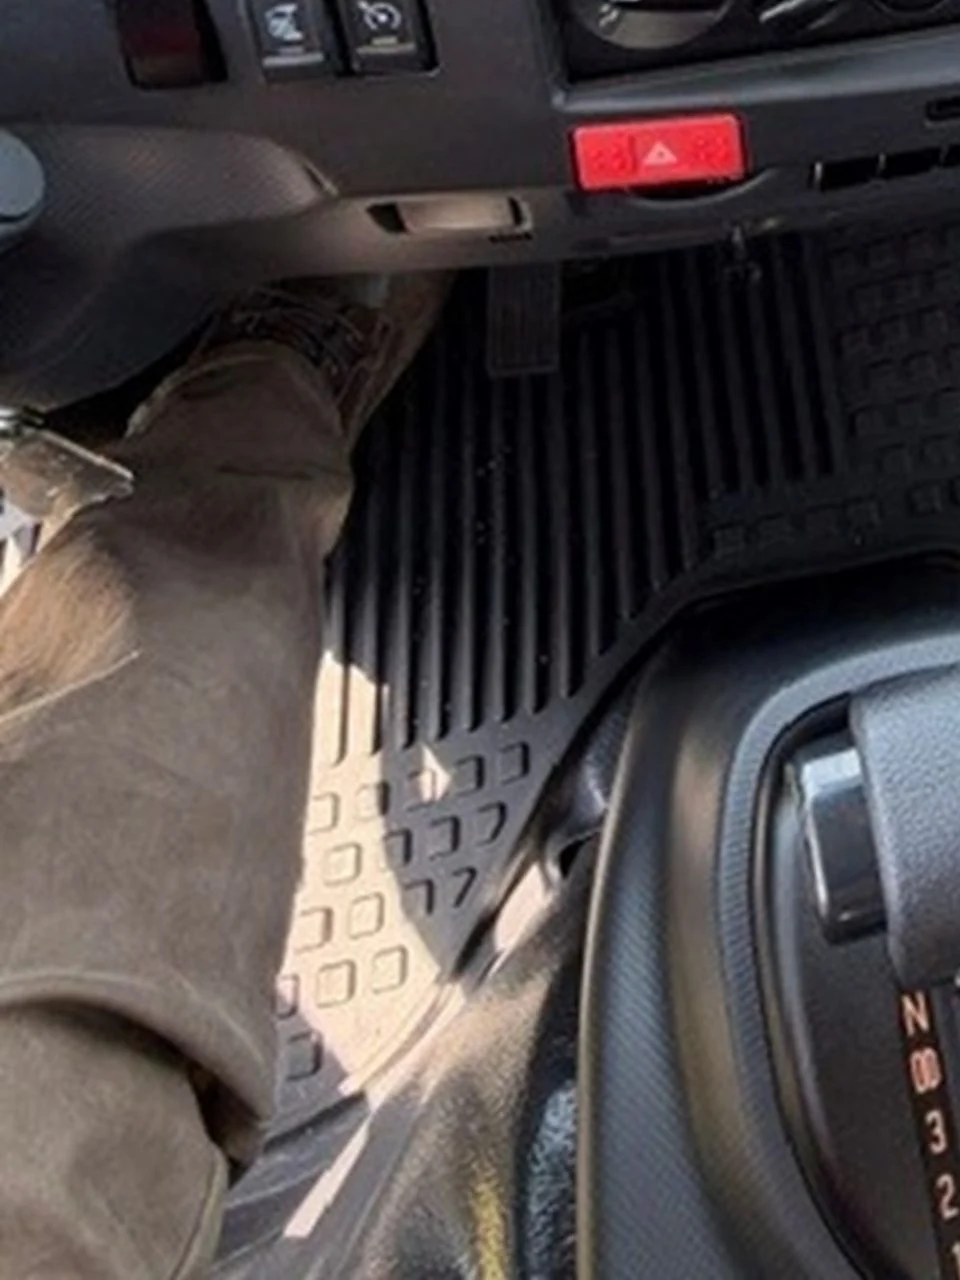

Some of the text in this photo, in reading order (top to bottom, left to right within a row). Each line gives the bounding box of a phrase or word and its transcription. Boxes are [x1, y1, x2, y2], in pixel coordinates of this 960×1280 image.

[901, 991, 930, 1035] N
[925, 1110, 948, 1154] 3
[935, 1173, 960, 1220] 2
